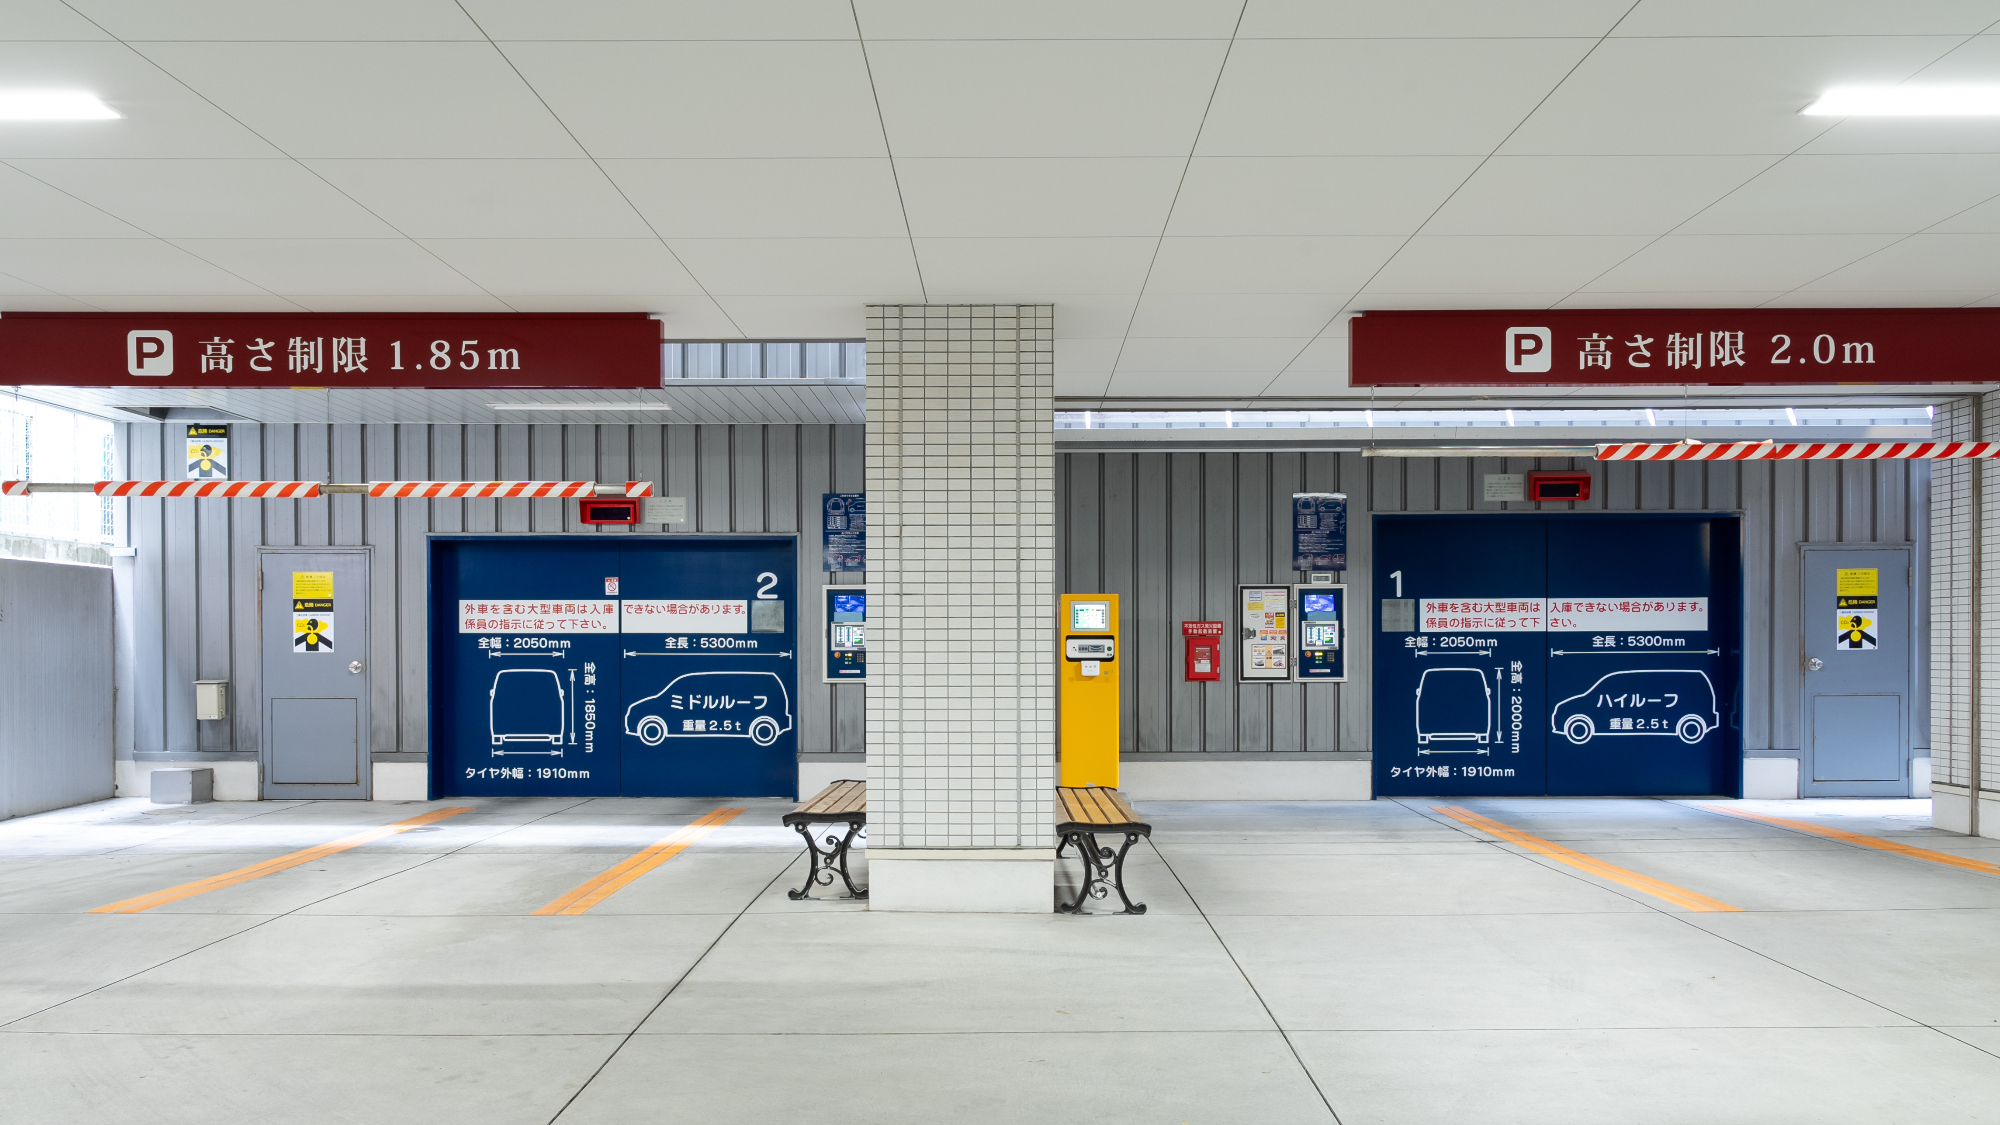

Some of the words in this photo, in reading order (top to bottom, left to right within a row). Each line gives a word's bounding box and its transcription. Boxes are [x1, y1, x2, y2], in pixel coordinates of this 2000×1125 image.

[198, 337, 369, 374] 高さ制限
[390, 339, 521, 371] 1.85m
[1577, 331, 1746, 370] 高さ制限
[1770, 333, 1876, 364] 2.0m
[756, 571, 779, 600] 2
[1389, 570, 1402, 598] 1
[464, 603, 614, 616] 外車を含む大型車両は入庫
[624, 603, 746, 616] できない場合があります。
[1426, 602, 1541, 614] 外車を含む大型車両は
[1550, 601, 1705, 614] 入庫できない場合があります。
[464, 618, 608, 631] 係員の指示に従って下さい。
[1425, 617, 1541, 629] 係員の指示に従って下
[670, 694, 768, 711] ミドルルーフ
[1596, 693, 1679, 709] ハイルーフ
[465, 766, 590, 780] タイヤ外幅：1910mm
[1390, 765, 1515, 779] タイヤ外幅：1910mm
